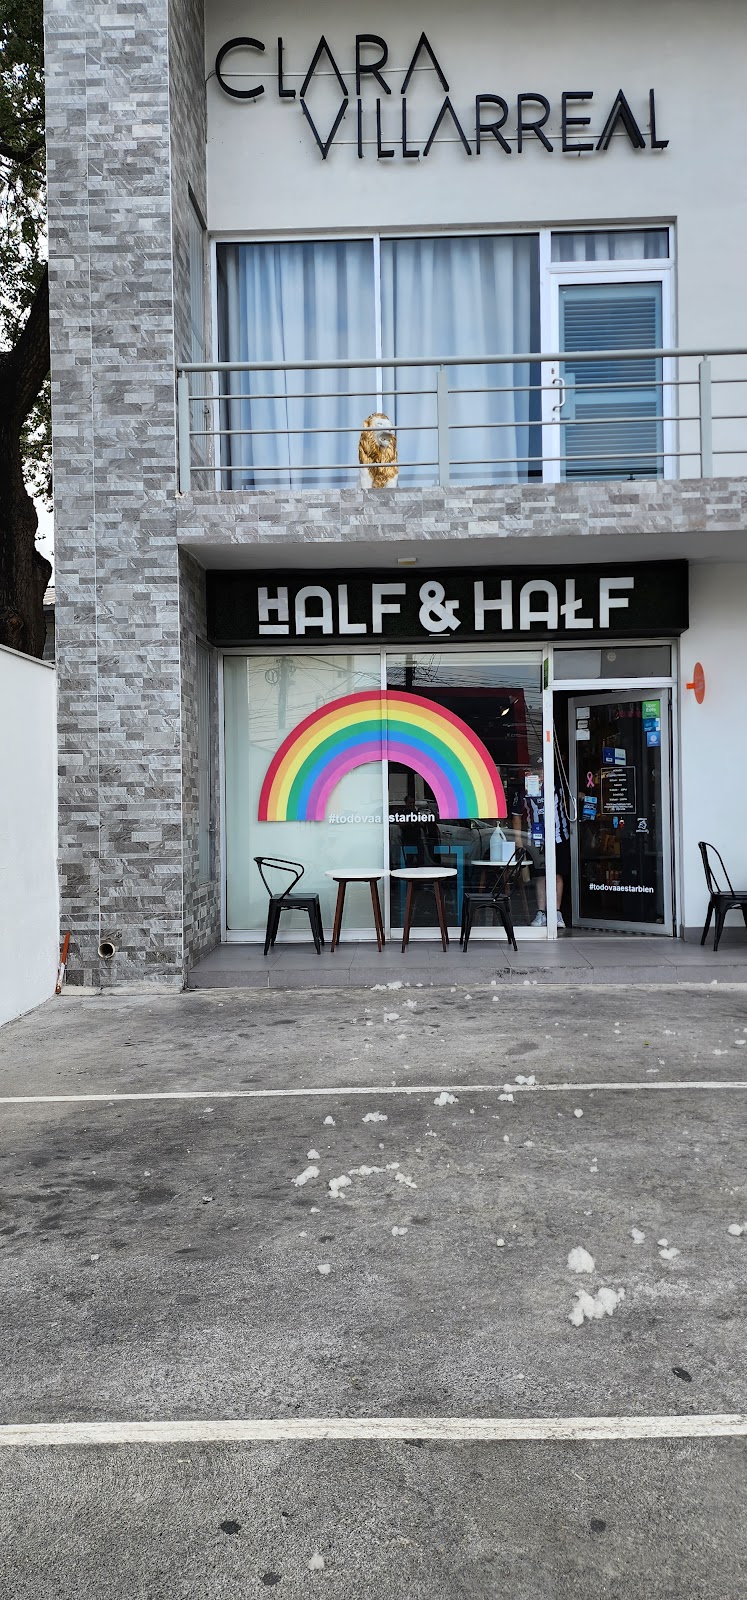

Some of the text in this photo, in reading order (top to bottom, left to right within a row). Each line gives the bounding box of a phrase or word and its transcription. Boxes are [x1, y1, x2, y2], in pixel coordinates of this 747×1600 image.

[215, 31, 450, 99] CLARA
[300, 88, 670, 160] VILLARREAL
[257, 582, 407, 635] HALF
[418, 580, 462, 636] &
[328, 812, 436, 824] #todovaastarbien
[589, 882, 655, 893] #todovaaestarbien
